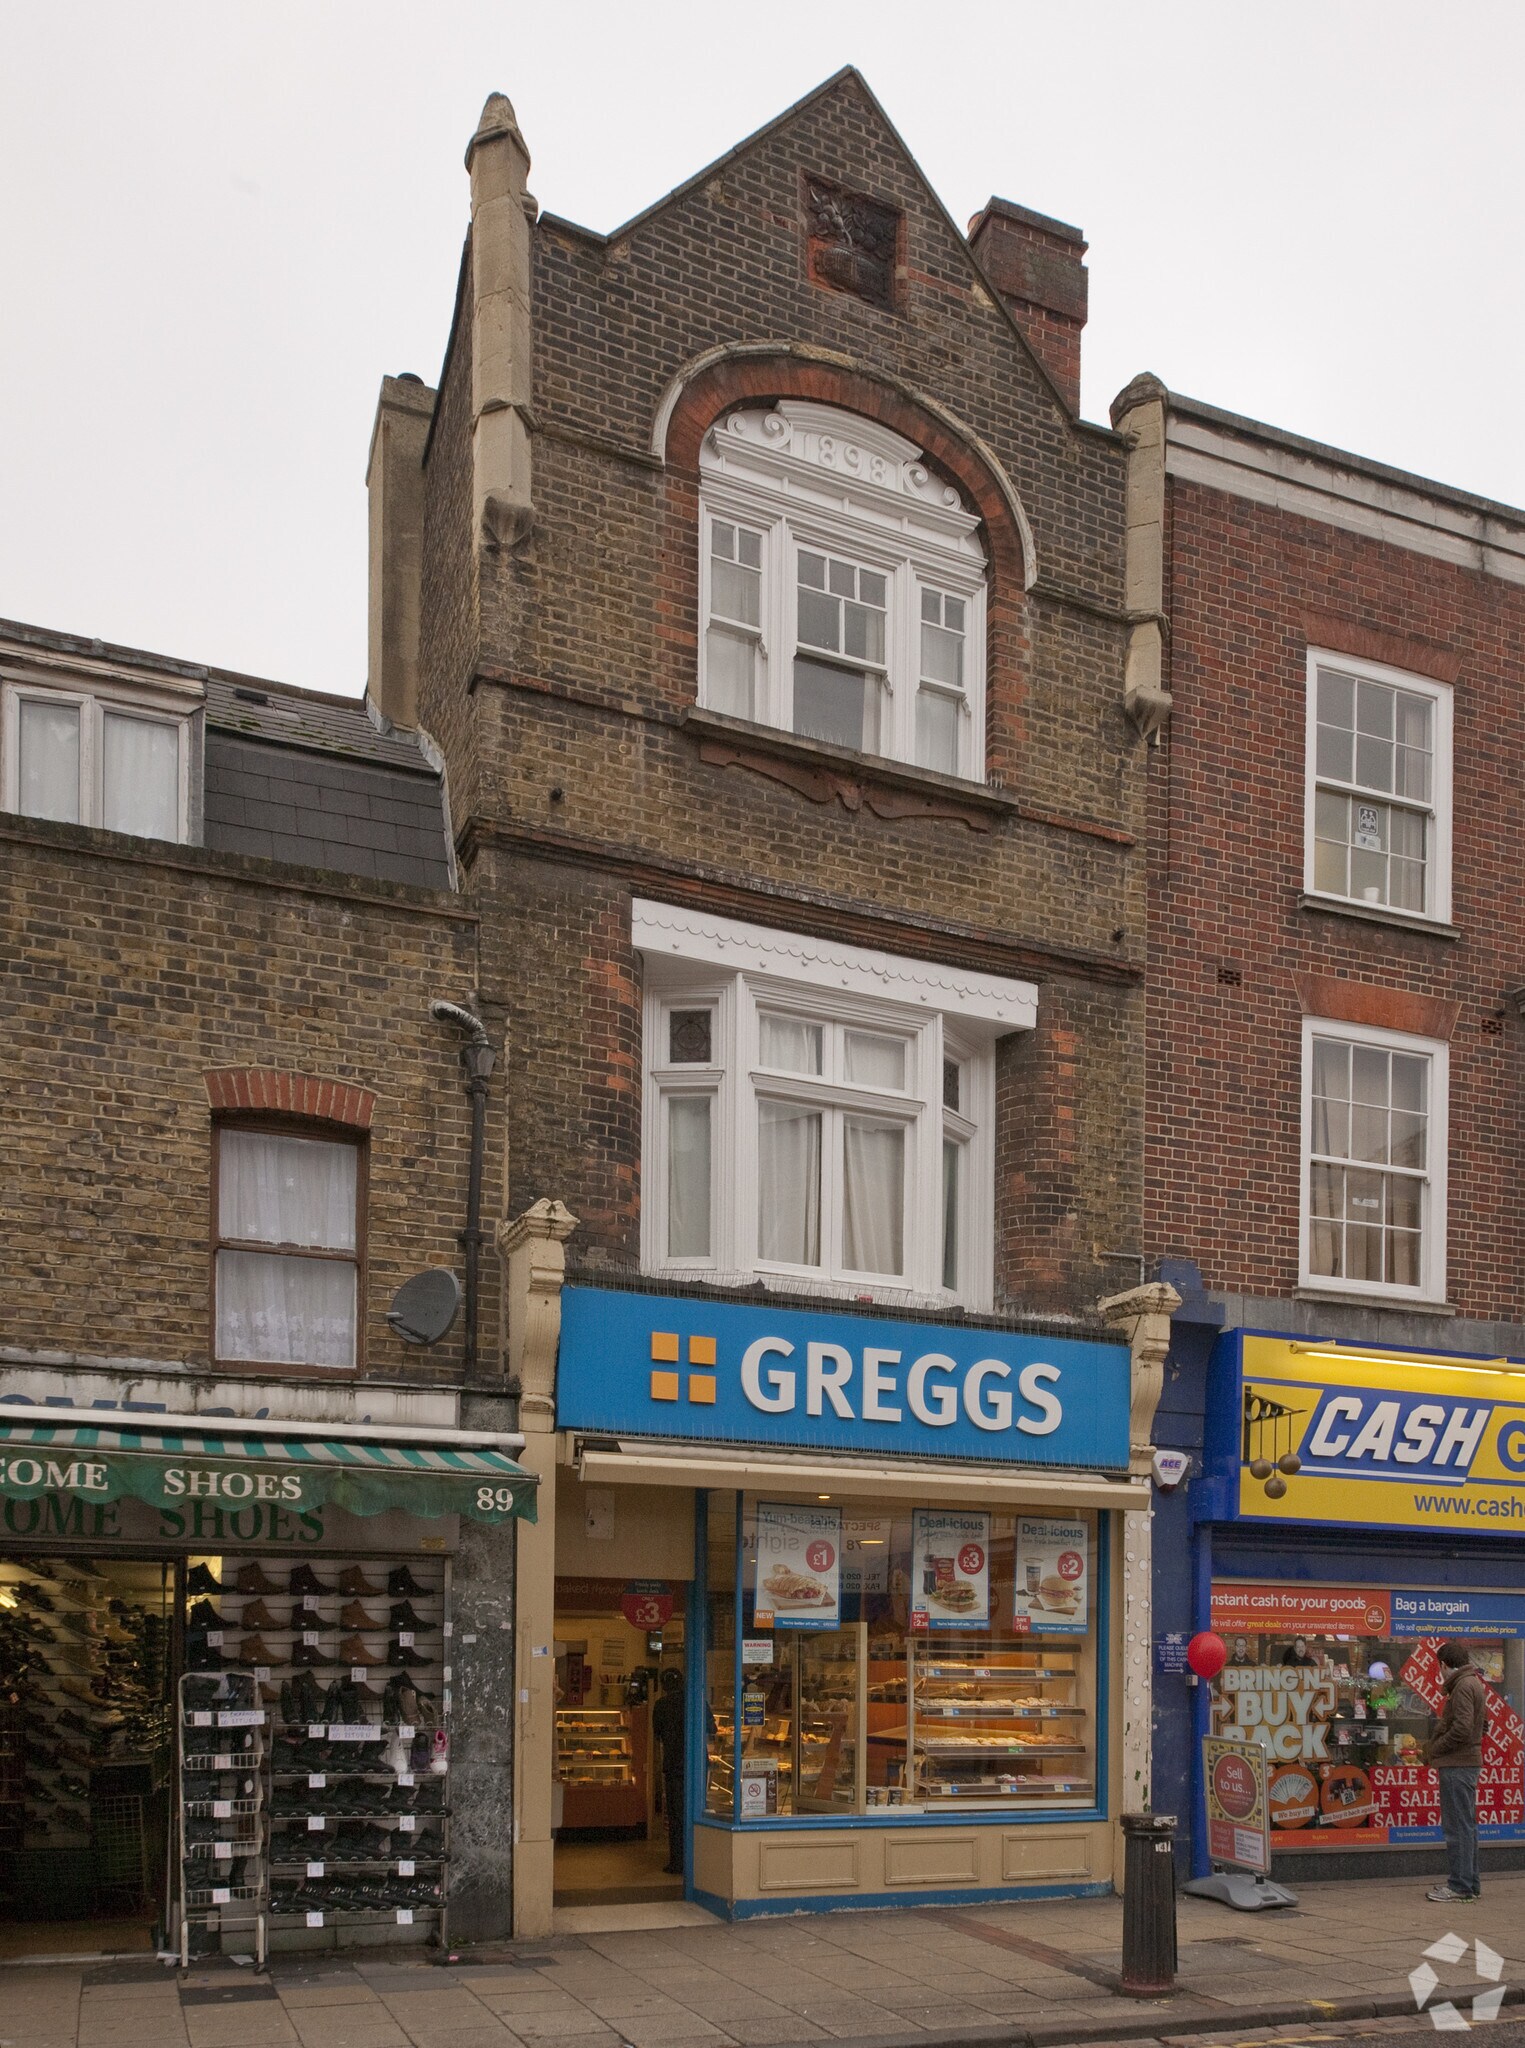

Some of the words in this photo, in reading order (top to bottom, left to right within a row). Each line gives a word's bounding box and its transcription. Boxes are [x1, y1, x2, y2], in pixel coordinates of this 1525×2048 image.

[803, 433, 887, 485] 1898
[740, 1336, 1063, 1436] GREGGS
[1309, 1396, 1490, 1467] CASH
[1160, 1459, 1182, 1469] ACE
[164, 1469, 302, 1500] SHOES
[476, 1487, 514, 1512] 89
[1414, 1495, 1525, 1518] www.cash
[159, 1501, 325, 1543] SHOES
[919, 1516, 985, 1531] Deal-icious
[1022, 1523, 1084, 1538] Deal-icious
[813, 1549, 827, 1566] £1
[963, 1552, 980, 1569] £3
[1062, 1559, 1079, 1575] £2
[1210, 1594, 1249, 1606] nstant
[1251, 1593, 1279, 1607] cash
[1281, 1594, 1299, 1608] for
[1300, 1598, 1328, 1611] your
[1330, 1597, 1366, 1612] goods
[1395, 1597, 1417, 1614] Bag
[1419, 1602, 1426, 1611] a
[1428, 1599, 1470, 1615] bargain
[635, 1602, 660, 1623] £3
[1220, 1619, 1231, 1627] will
[1231, 1620, 1247, 1628] offer
[1247, 1621, 1264, 1629] great
[1307, 1622, 1338, 1630] unwanted
[1395, 1623, 1405, 1631] We
[1416, 1624, 1436, 1633] quality
[1437, 1625, 1463, 1633] products
[1470, 1625, 1499, 1633] affordable
[1499, 1627, 1518, 1635] prices
[1404, 1666, 1444, 1709] SALE
[1238, 1691, 1315, 1726] BUY
[1485, 1690, 1504, 1716] LE
[1487, 1719, 1512, 1752] ALE
[1227, 1766, 1243, 1780] Sell
[1374, 1768, 1418, 1786] SALE
[1479, 1767, 1520, 1784] SALE
[1220, 1779, 1230, 1790] to
[1400, 1790, 1440, 1807] SALE
[1374, 1812, 1418, 1828] SALE
[1479, 1810, 1520, 1825] SALE
